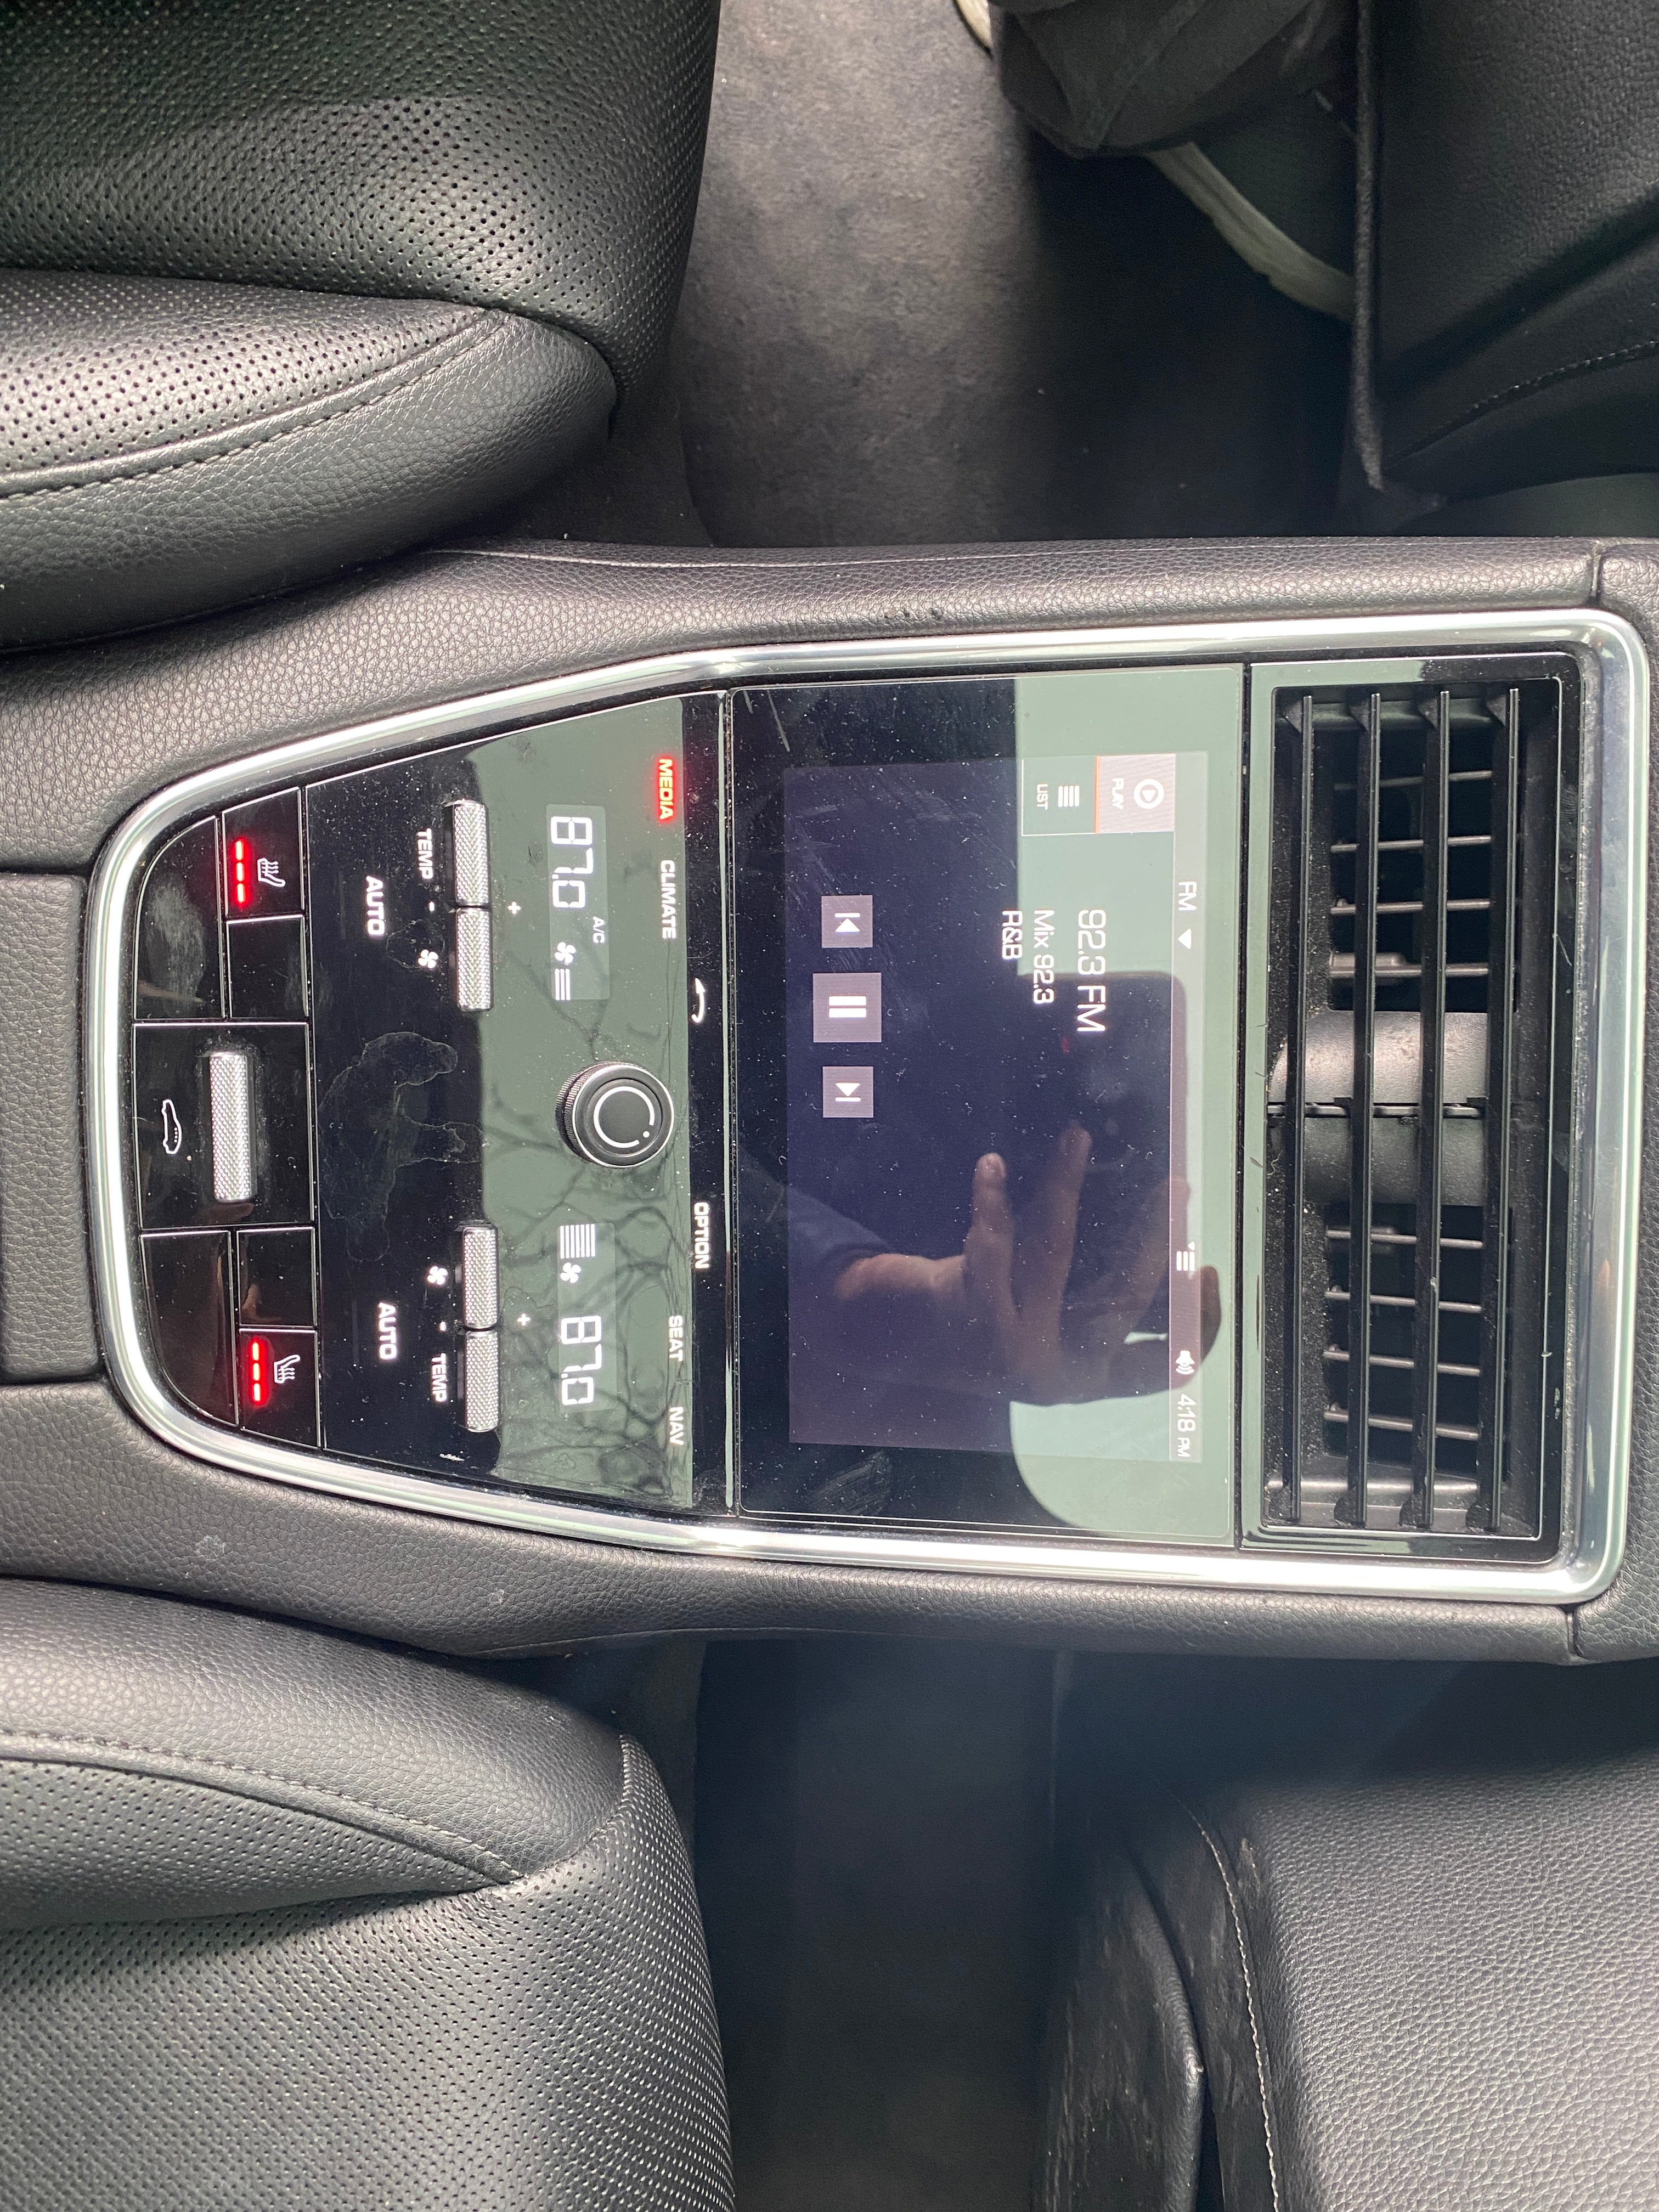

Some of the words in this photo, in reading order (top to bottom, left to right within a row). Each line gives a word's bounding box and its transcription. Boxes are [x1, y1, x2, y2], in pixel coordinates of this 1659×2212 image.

[658, 759, 672, 819] MEDIA
[1037, 783, 1048, 809] LIST
[1111, 778, 1124, 809] PLAY
[417, 828, 433, 878] TEMP
[551, 816, 593, 908] 87.0
[366, 876, 384, 935] AUTO
[661, 860, 676, 939] CLIMATE
[1178, 881, 1196, 911] FM
[592, 916, 606, 944] A/C
[1001, 910, 1023, 960] R&B
[1033, 910, 1053, 949] Mix
[1076, 910, 1105, 975] 92.3
[1032, 955, 1053, 1004] 92.3
[1077, 984, 1104, 1032] FM
[693, 1202, 710, 1269] OPTION
[378, 1302, 396, 1360] AUTO
[668, 1315, 683, 1362] SEAT
[431, 1353, 447, 1402] TEMP
[561, 1316, 602, 1406] 87.0
[668, 1407, 684, 1445] NAV
[1177, 1393, 1194, 1432] 4:18
[1178, 1436, 1189, 1457] PM
